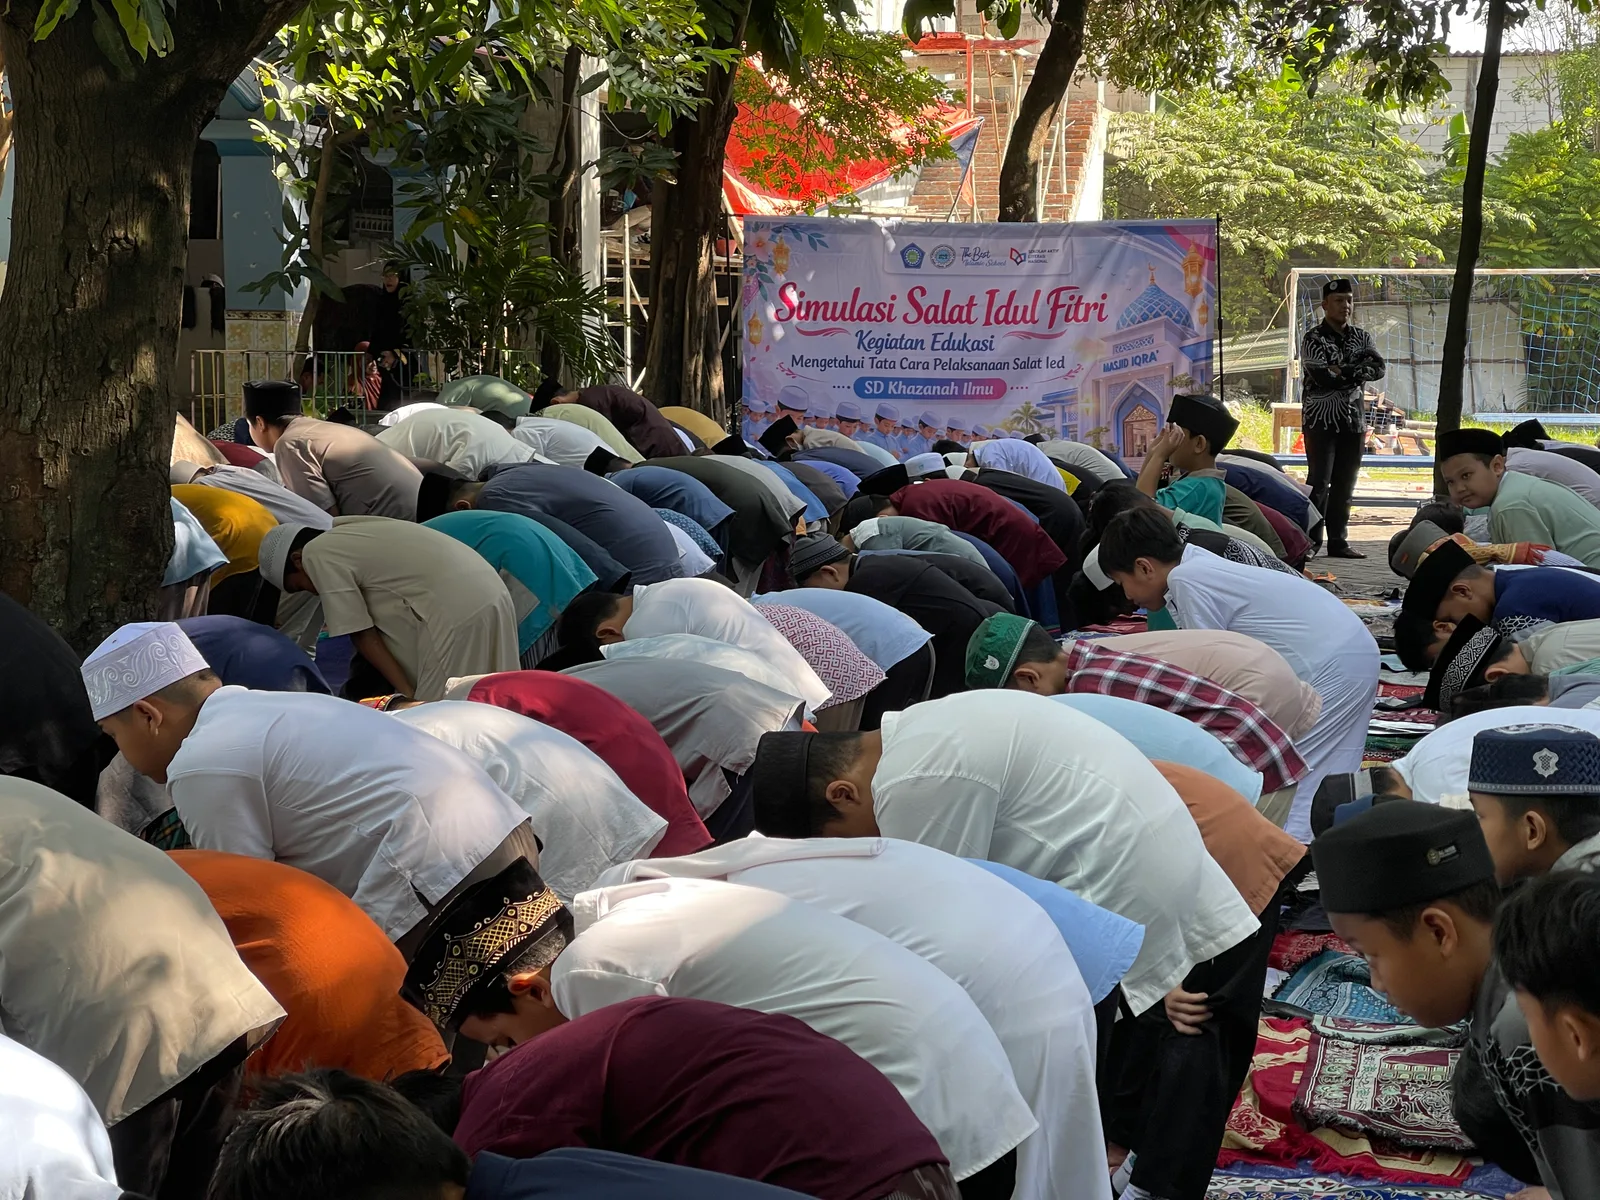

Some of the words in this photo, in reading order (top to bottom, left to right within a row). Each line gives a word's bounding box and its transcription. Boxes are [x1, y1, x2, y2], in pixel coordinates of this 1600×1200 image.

[960, 246, 971, 261] The
[971, 246, 991, 261] Best
[774, 281, 897, 323] Simulasi
[902, 285, 978, 325] Salat
[982, 288, 1042, 327] Idul
[1046, 285, 1109, 330] Fitri
[855, 329, 926, 355] Kegiatan
[930, 332, 995, 353] Edukasi
[791, 354, 865, 372] Mengetahui
[868, 356, 897, 370] Tata
[900, 356, 930, 371] Cara
[933, 357, 1010, 371] Pelaksanaan
[1012, 356, 1042, 370] Salat
[1103, 358, 1129, 373] MASJID
[864, 380, 884, 395] SD
[888, 381, 959, 396] Khazanah
[963, 382, 994, 396] Ilmu
